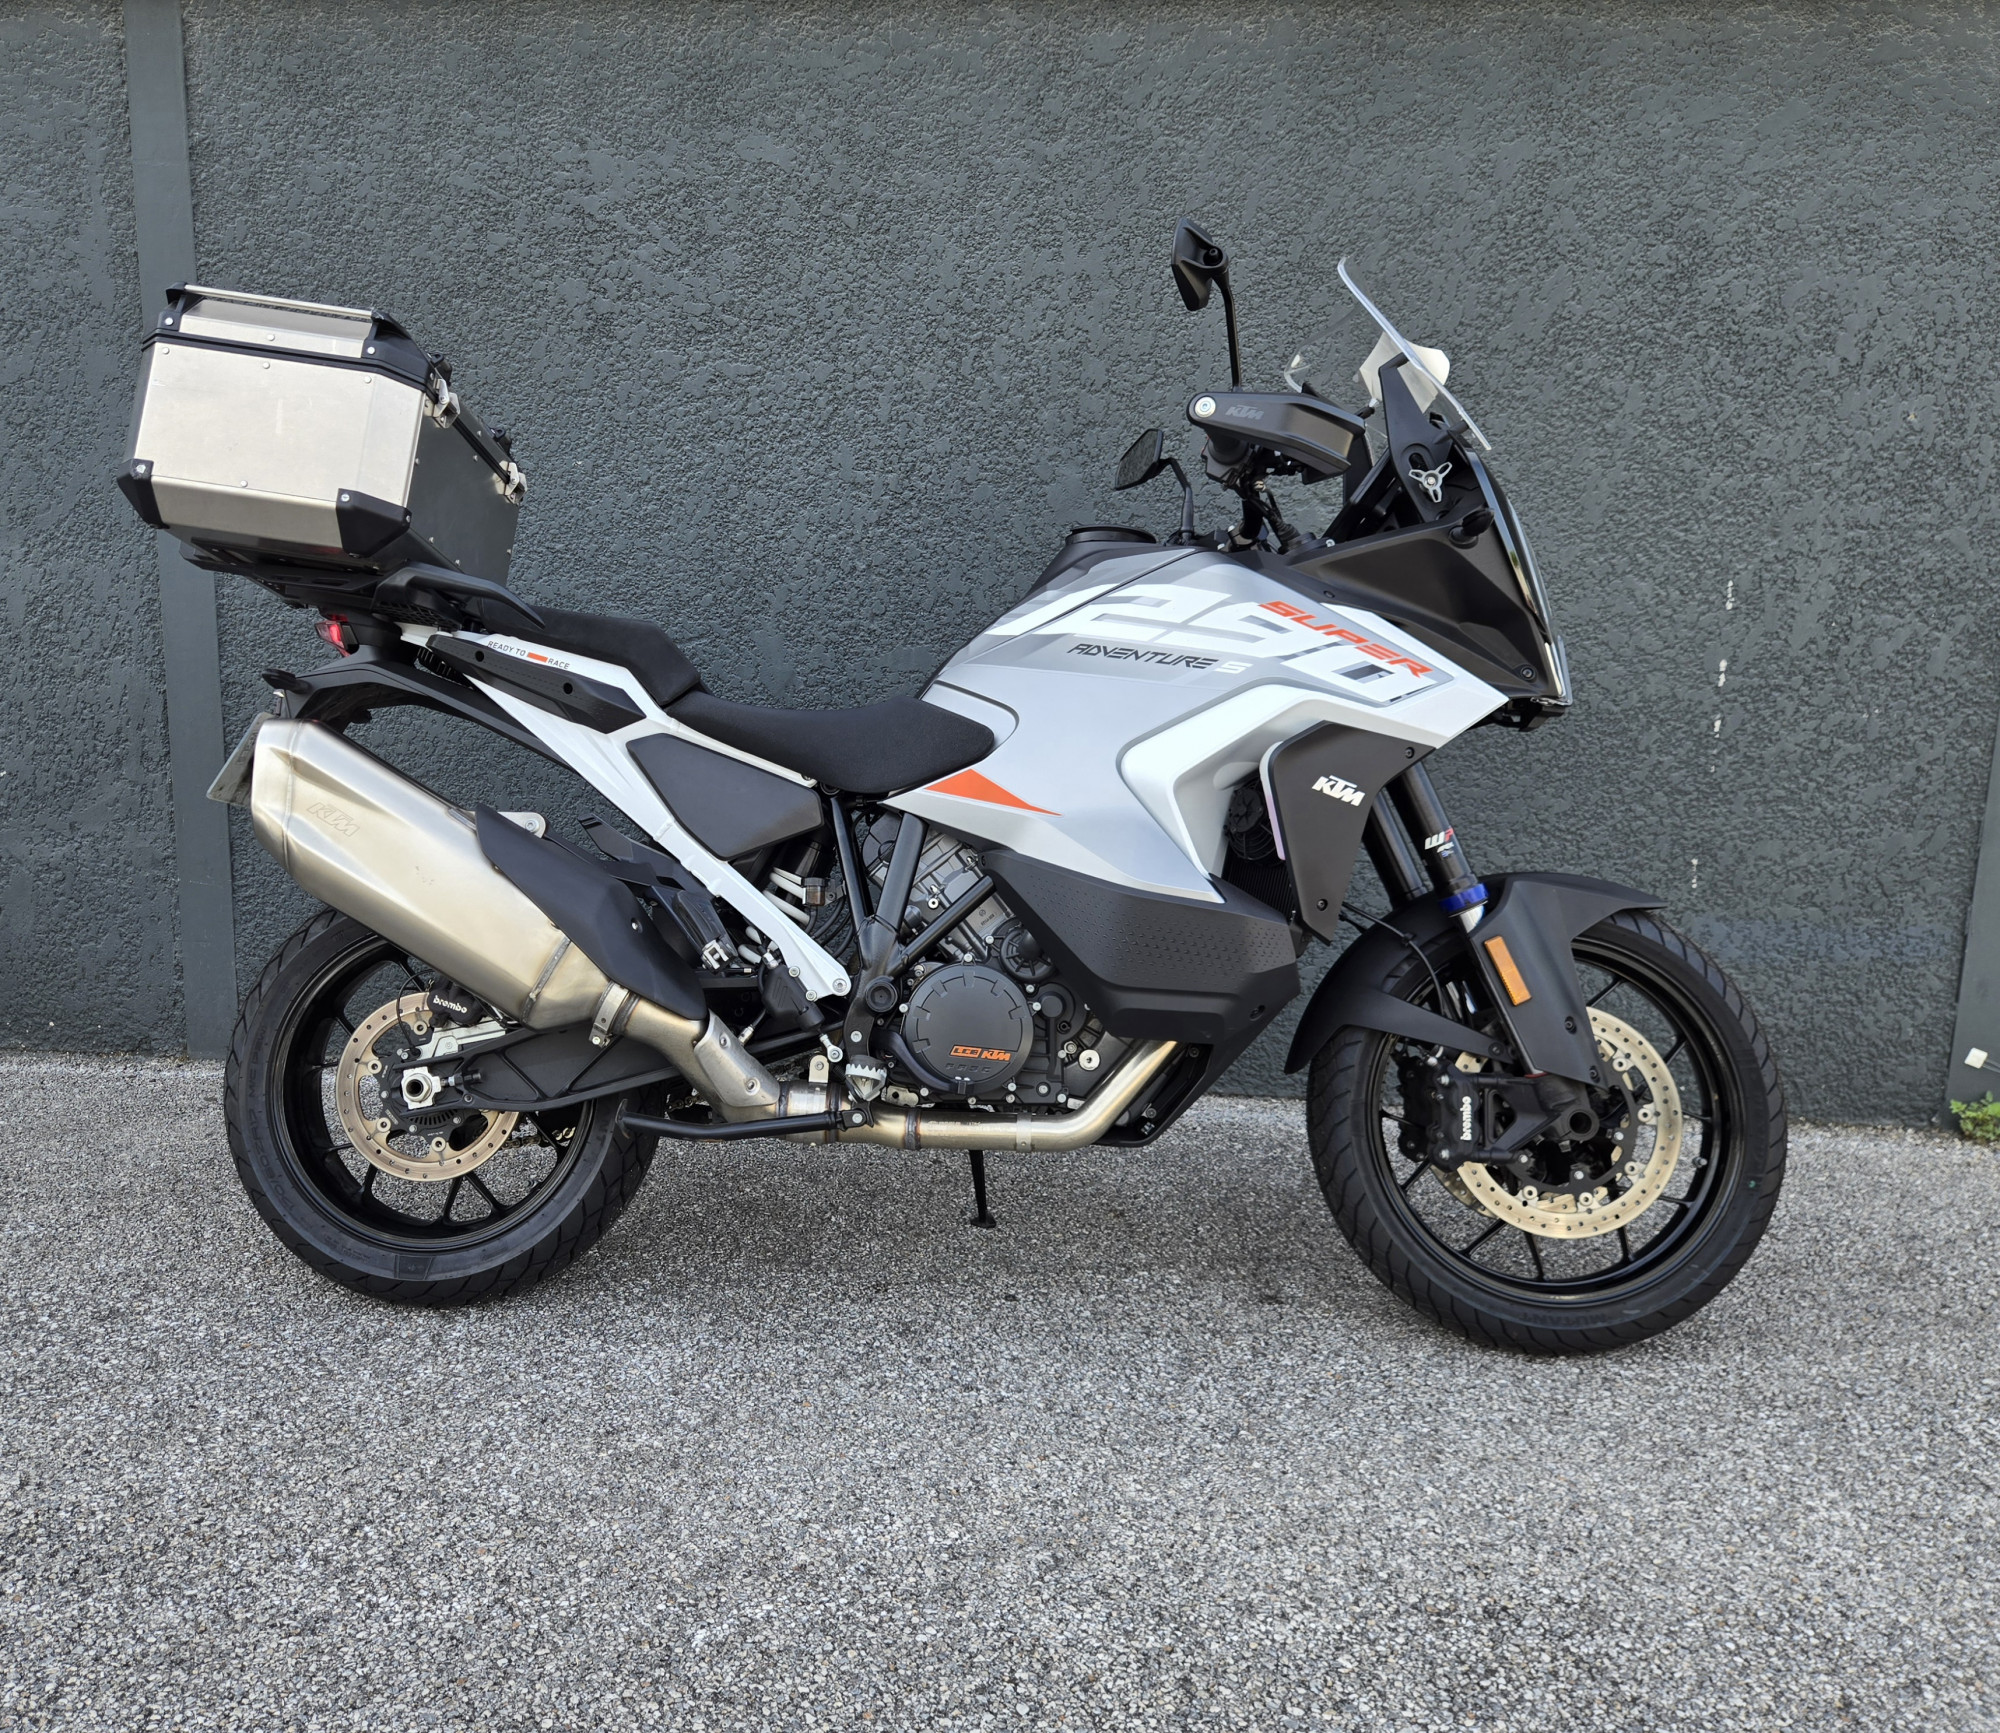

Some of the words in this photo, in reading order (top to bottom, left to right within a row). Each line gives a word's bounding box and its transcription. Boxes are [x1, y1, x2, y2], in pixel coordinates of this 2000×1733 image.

[1225, 404, 1264, 420] KTM
[487, 640, 514, 653] READY
[515, 648, 526, 657] TO
[547, 657, 570, 670] RACE
[1258, 600, 1433, 678] SUPER
[1067, 643, 1219, 670] ADVENTURE
[1214, 661, 1253, 675] S
[1311, 774, 1366, 807] KTM
[306, 802, 361, 837] KTM
[432, 994, 468, 1014] brembo
[981, 1048, 1011, 1061] KTM
[1459, 1095, 1472, 1141] brembo
